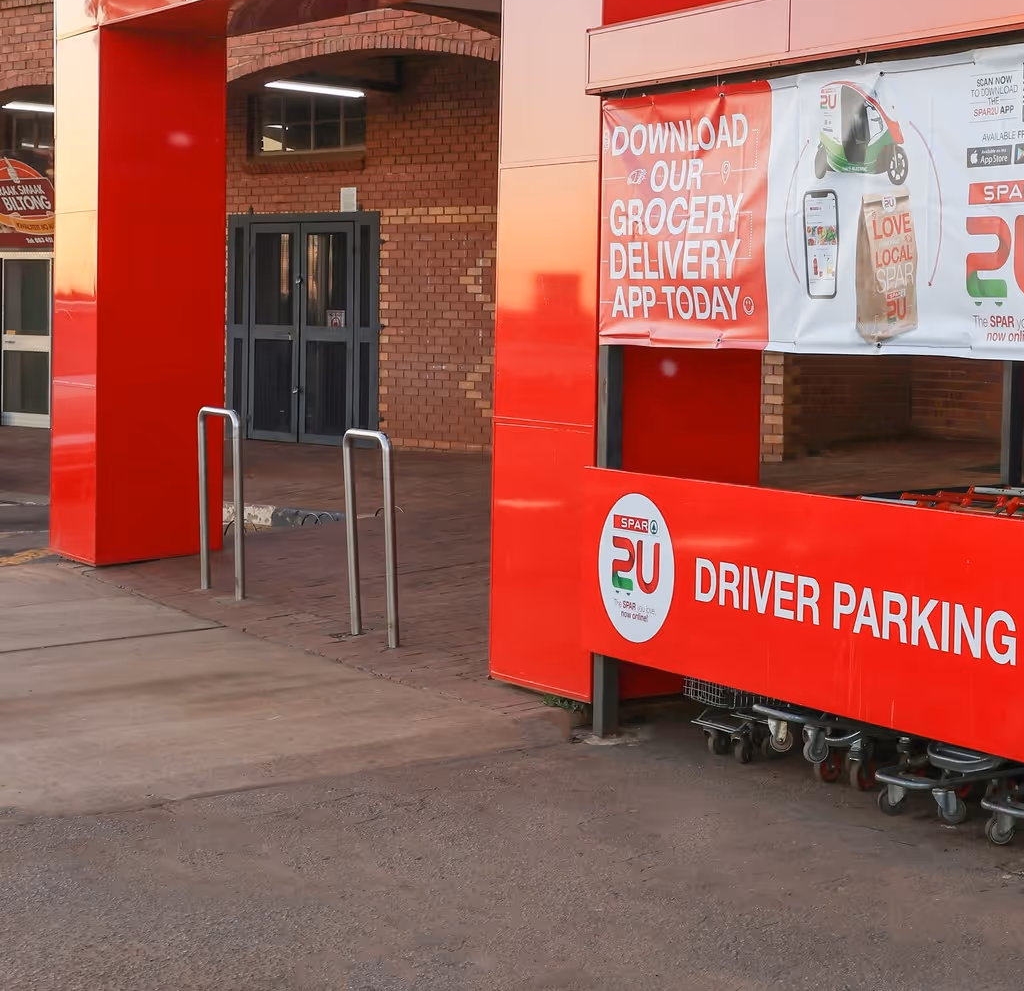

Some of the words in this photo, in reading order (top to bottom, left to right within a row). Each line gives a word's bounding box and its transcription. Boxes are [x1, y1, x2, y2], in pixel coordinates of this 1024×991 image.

[976, 78, 994, 87] SCAN
[995, 75, 1013, 85] NOW
[970, 89, 980, 98] TO
[981, 84, 1019, 97] DOWNLOAD
[987, 97, 999, 105] THE
[973, 107, 999, 117] SPAR2U
[1000, 105, 1015, 115] APP
[611, 113, 749, 157] DOWNLOAD
[982, 131, 1016, 142] AVAILABLE
[980, 156, 993, 165] App
[993, 154, 1009, 163] Store
[650, 158, 704, 193] OUR
[1, 195, 52, 211] BILTONG
[610, 193, 744, 236] GROCERY
[872, 212, 912, 240] LOVE
[609, 238, 742, 280] DELIVERY
[875, 244, 913, 268] LOCAL
[876, 262, 914, 294] SPAR
[611, 286, 657, 318] APP
[661, 285, 741, 320] TODAY
[972, 315, 988, 328] The
[990, 315, 1015, 328] SPAR
[986, 332, 1007, 342] now
[621, 517, 648, 531] SPAR
[612, 536, 660, 594] 2U
[622, 600, 637, 611] SPAR
[694, 557, 820, 626] DRIVER
[832, 582, 1017, 666] PARKING
[621, 610, 632, 619] now
[632, 611, 649, 622] online!
